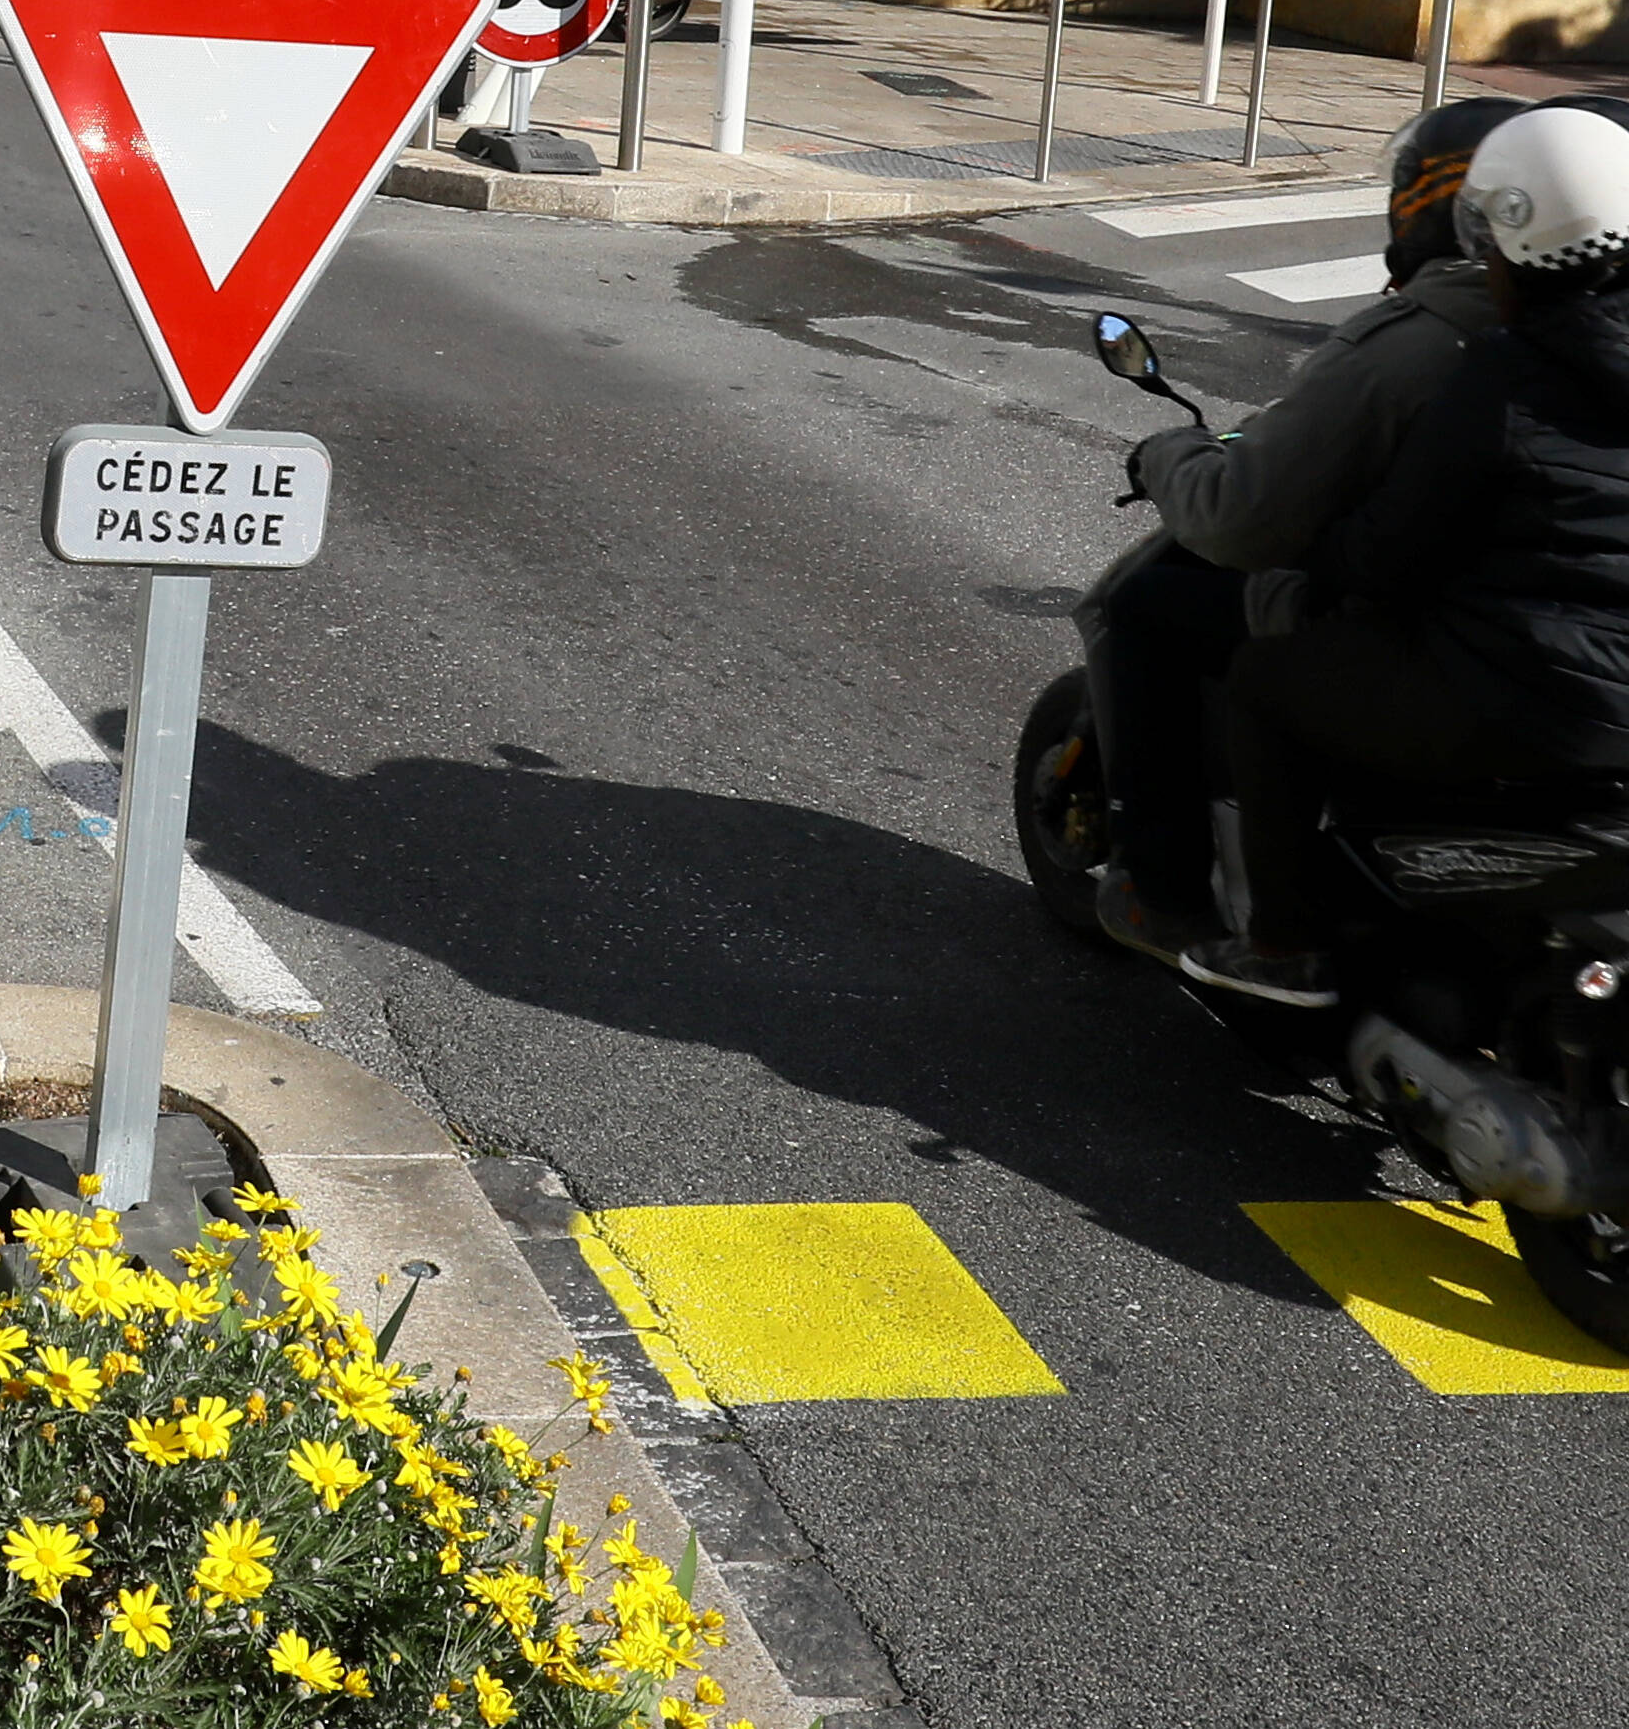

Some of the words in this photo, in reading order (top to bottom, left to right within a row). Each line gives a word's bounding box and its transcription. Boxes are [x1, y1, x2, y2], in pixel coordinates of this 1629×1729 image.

[96, 450, 229, 495] CÉDEZ
[252, 464, 296, 498] LE
[95, 508, 285, 546] PASSAGE
